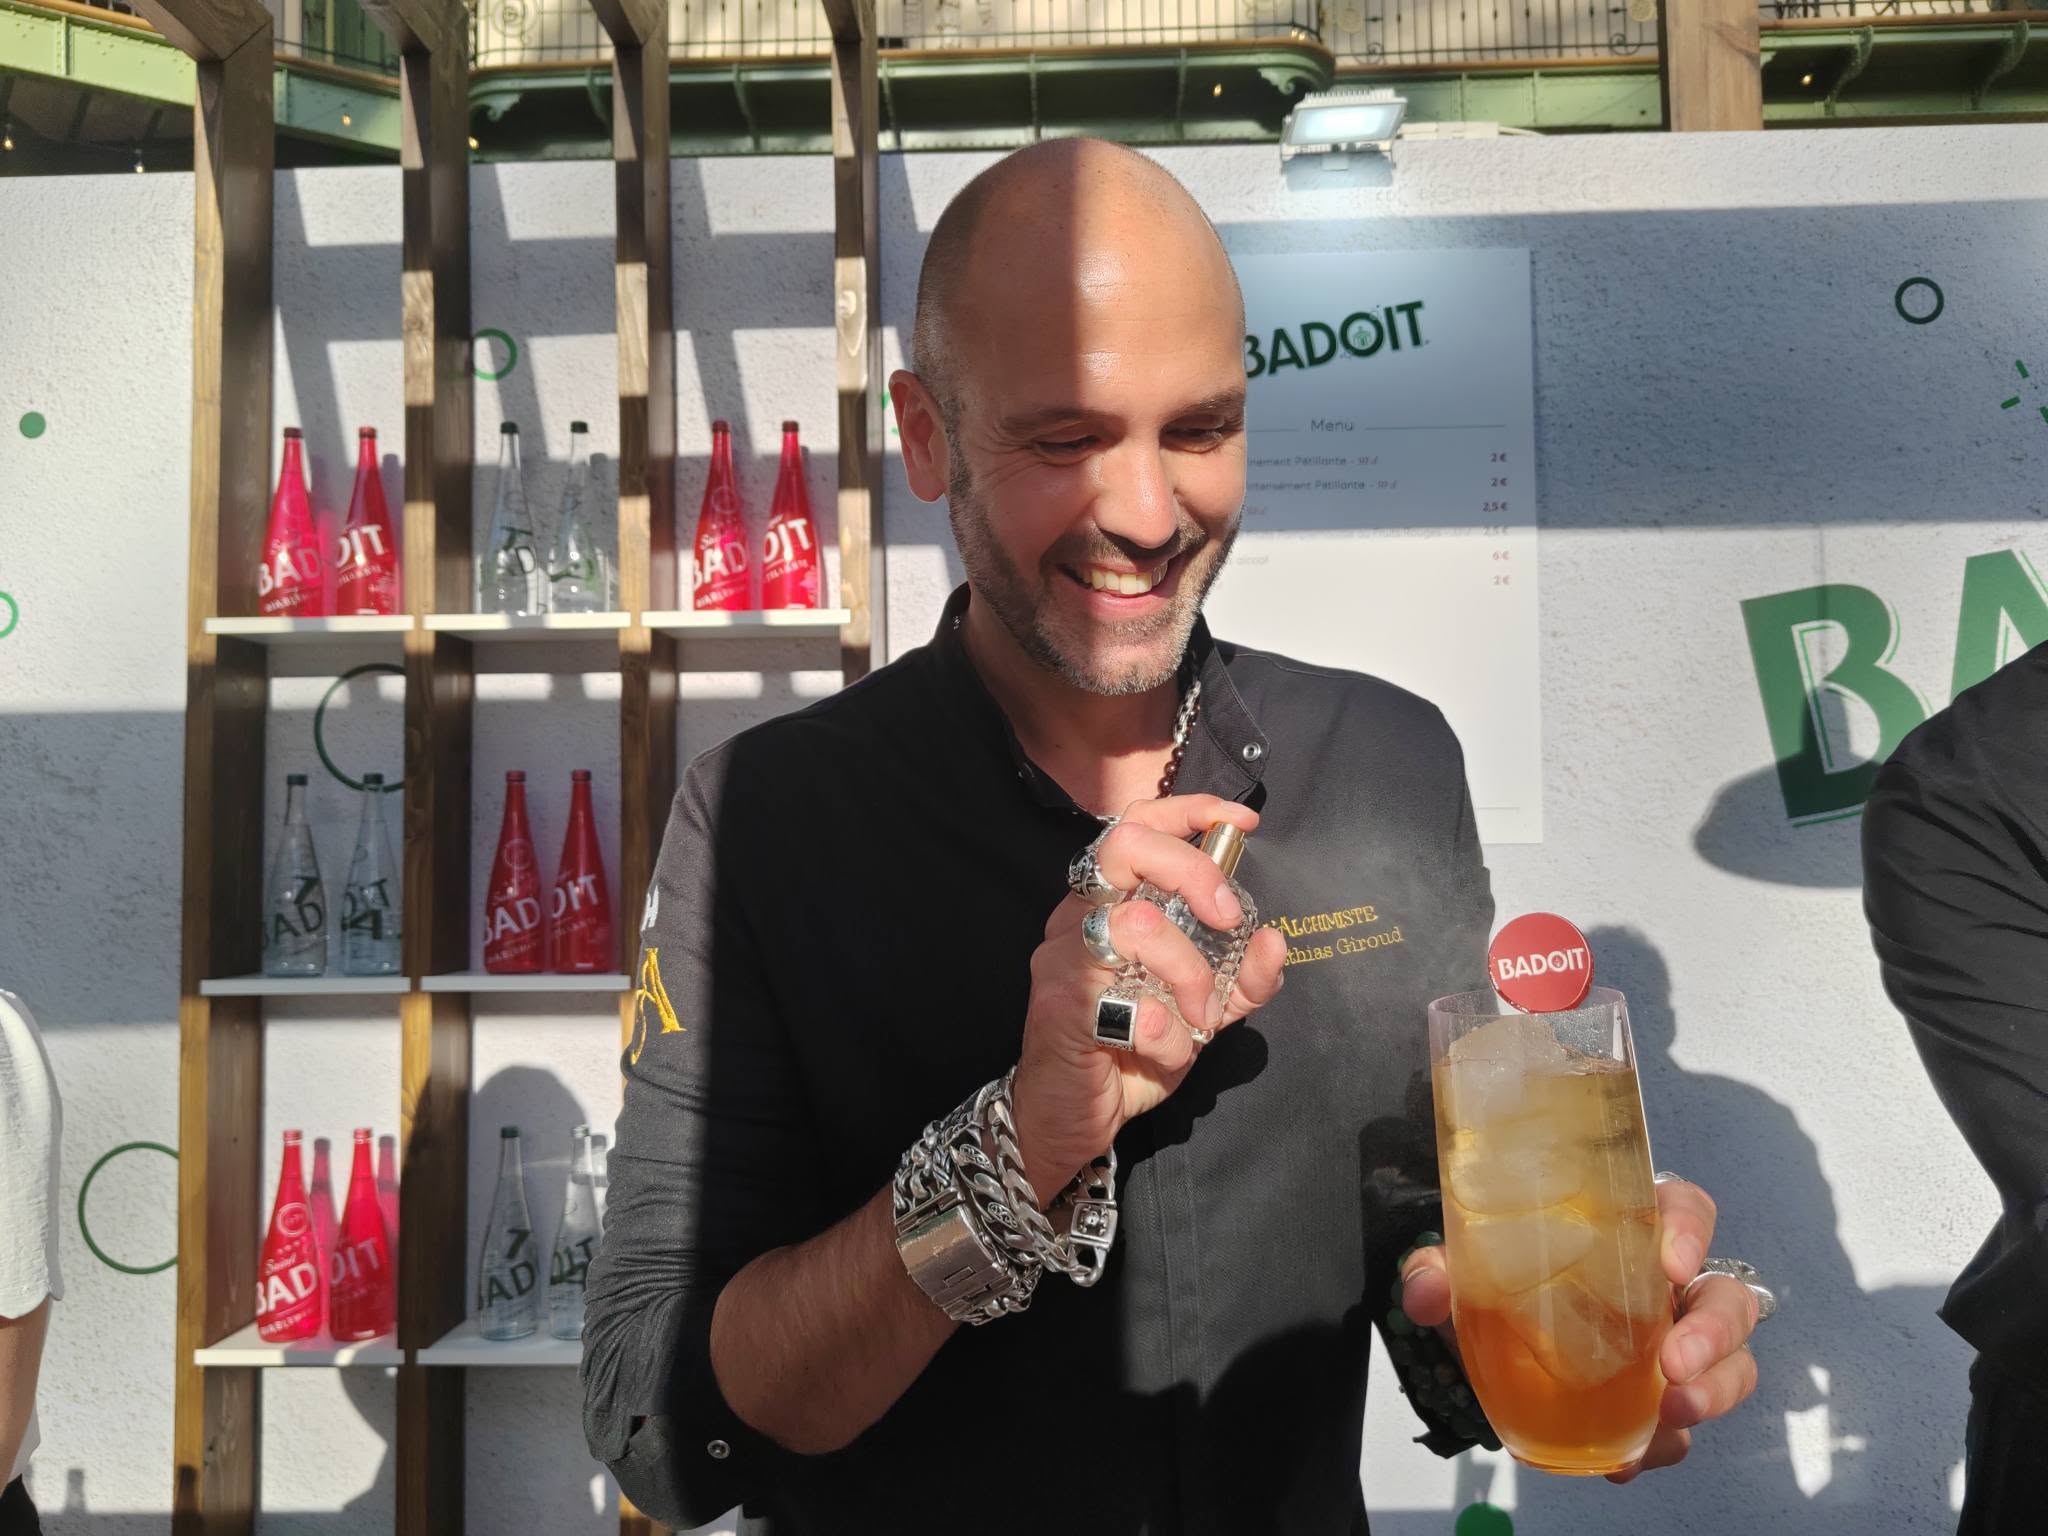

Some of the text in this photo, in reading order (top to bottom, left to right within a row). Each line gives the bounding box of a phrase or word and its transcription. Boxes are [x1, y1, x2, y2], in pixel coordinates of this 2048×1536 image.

[1311, 419, 1355, 432] Menu
[1336, 925, 1405, 955] Giroud
[1497, 947, 1585, 981] BADOIT
